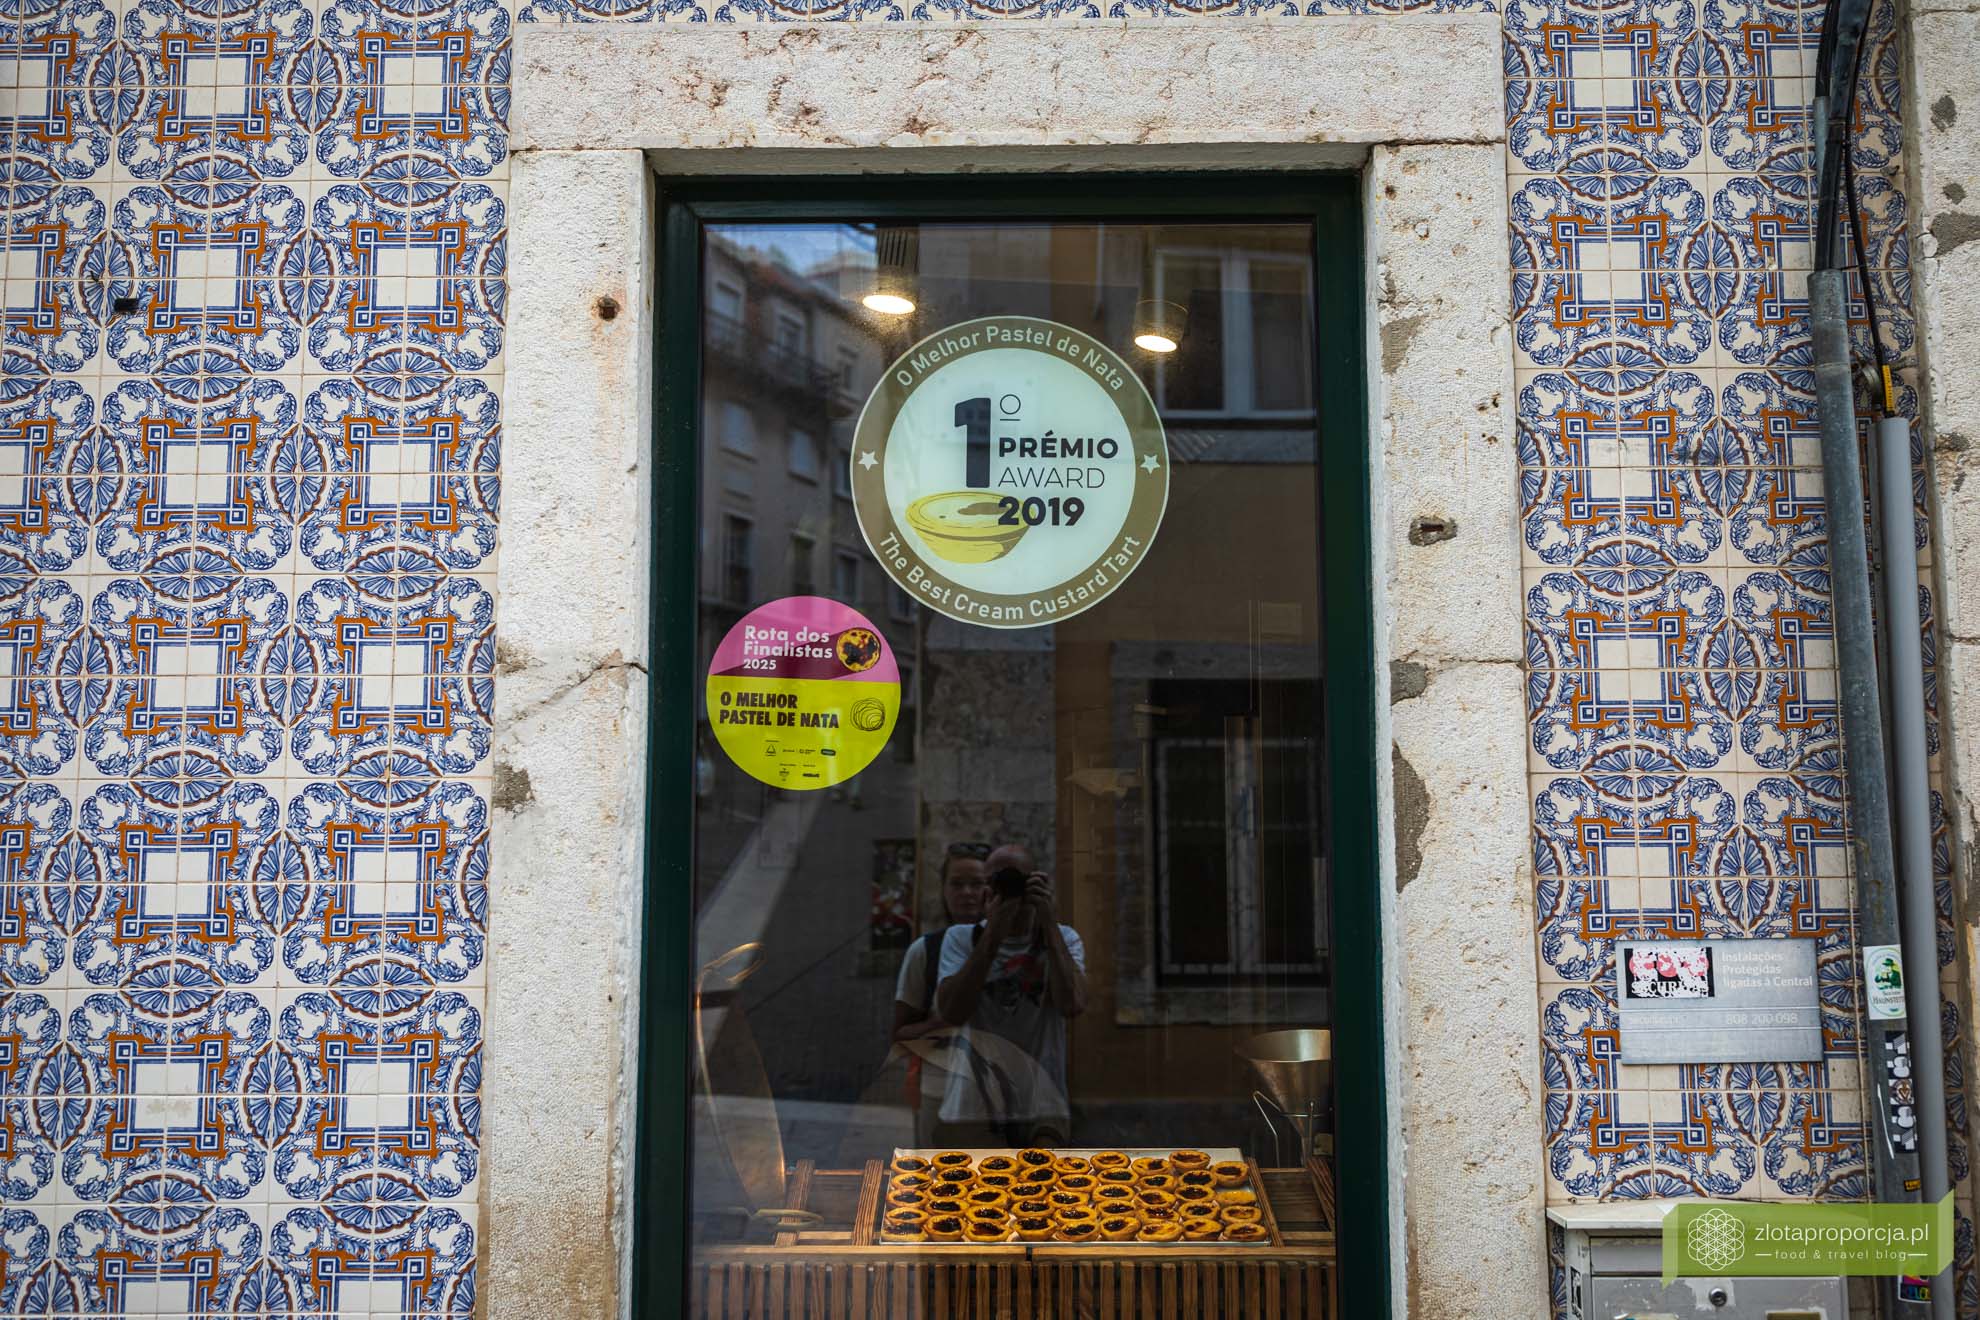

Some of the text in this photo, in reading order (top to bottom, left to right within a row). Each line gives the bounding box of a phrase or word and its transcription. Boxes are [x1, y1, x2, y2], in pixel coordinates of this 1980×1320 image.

[896, 326, 1125, 390] O Melhor Pastel de Nata
[999, 430, 1119, 459] PRÉMIO
[998, 467, 1105, 488] AWARD
[998, 496, 1085, 526] 2019
[880, 532, 1140, 620] The Best Cream Custard Tart
[745, 625, 830, 643] Rota dos
[744, 641, 833, 659] Finalistas
[743, 659, 777, 670] 2025
[720, 691, 798, 709] O MELHOR
[719, 710, 839, 728] PASTEL DE NATA
[1722, 965, 1782, 977] Protegidas
[1775, 976, 1813, 987] Central
